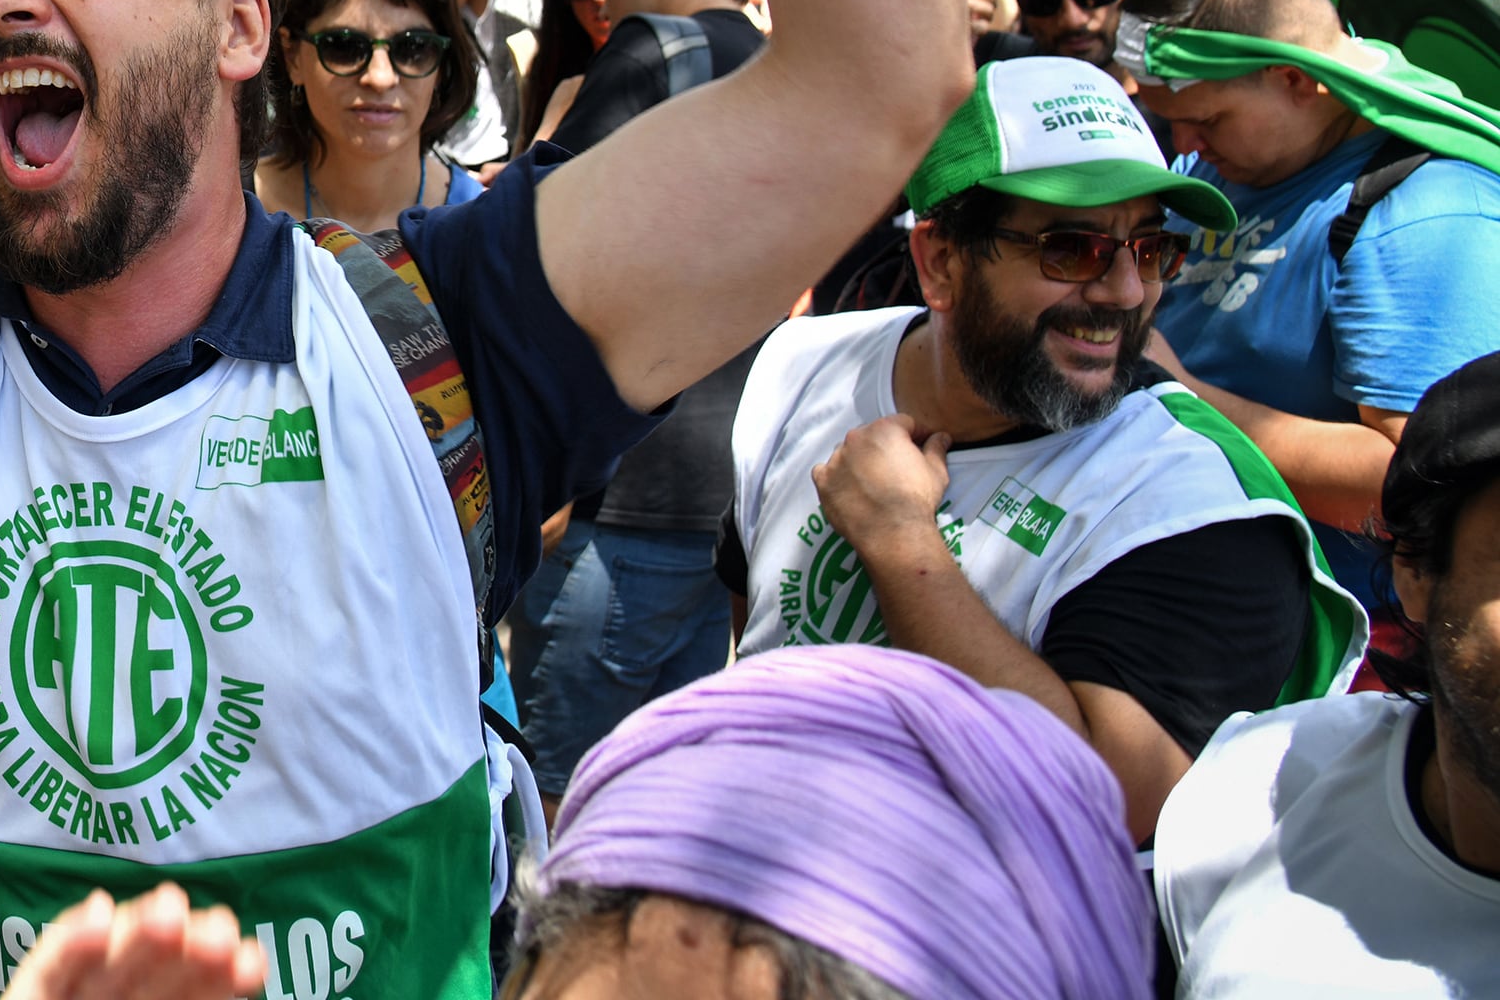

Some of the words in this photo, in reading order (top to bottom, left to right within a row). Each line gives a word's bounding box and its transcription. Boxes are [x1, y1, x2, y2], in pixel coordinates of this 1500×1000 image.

[1031, 93, 1116, 113] tenemos
[206, 437, 261, 468] VERDE
[263, 429, 321, 461] BLANC
[124, 485, 165, 539] EL
[163, 498, 255, 634] ESTADO
[779, 568, 804, 631] PARA
[32, 562, 185, 767] ATE
[1, 746, 141, 846] LIBERAR
[139, 784, 197, 843] LA
[179, 674, 266, 812] NACION
[255, 909, 366, 1000] LOS
